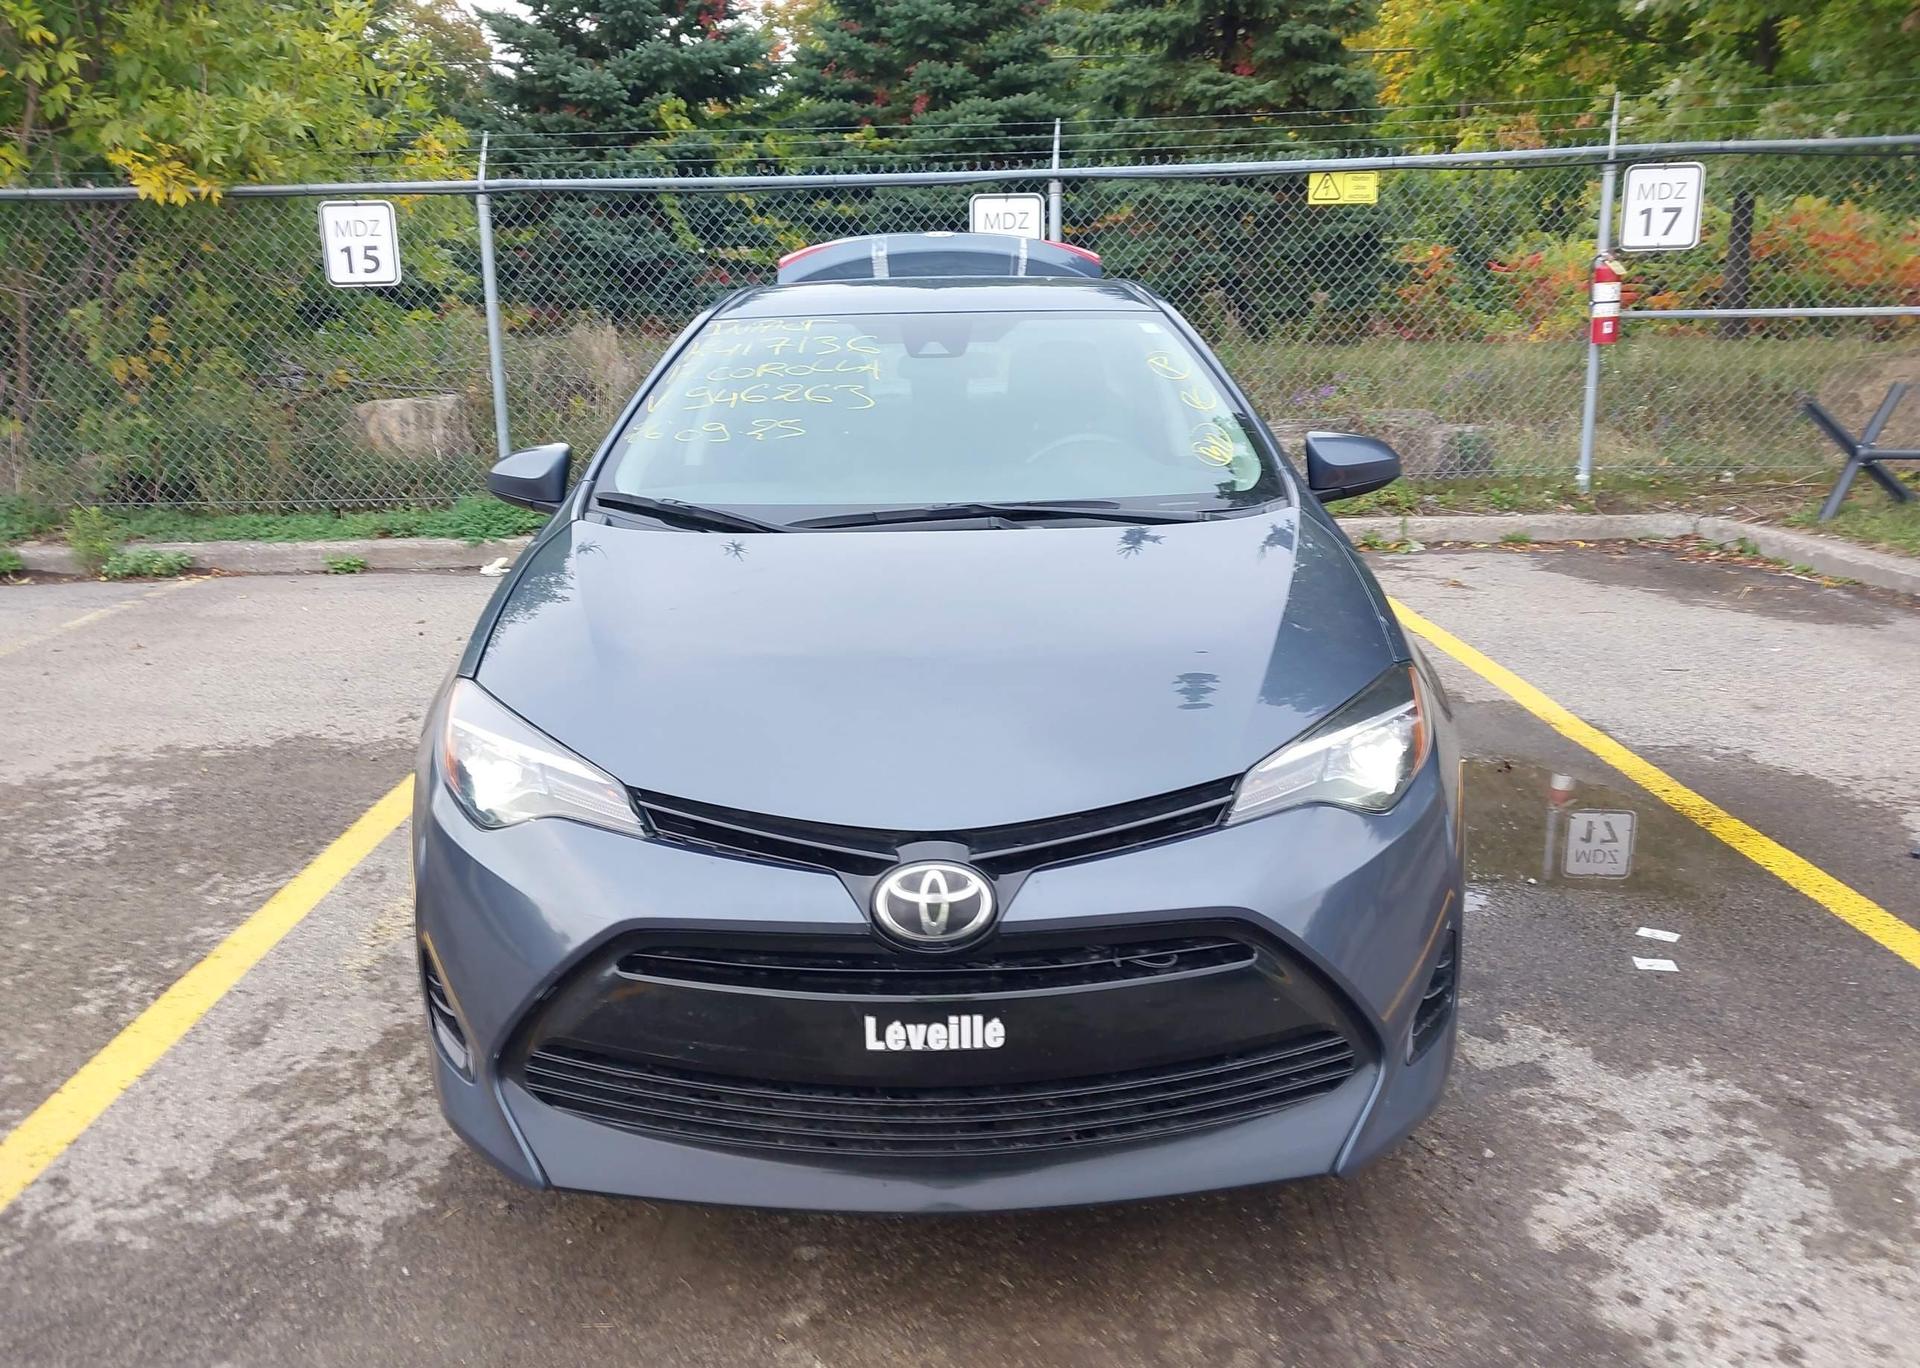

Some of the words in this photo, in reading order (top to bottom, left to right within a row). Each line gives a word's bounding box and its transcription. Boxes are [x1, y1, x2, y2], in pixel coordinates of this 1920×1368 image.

[1637, 182, 1688, 201] MDZ
[335, 220, 381, 237] MDZ
[984, 212, 1029, 230] MDZ
[1639, 207, 1683, 236] 17
[340, 246, 380, 273] 15
[706, 360, 880, 379] COROLLA
